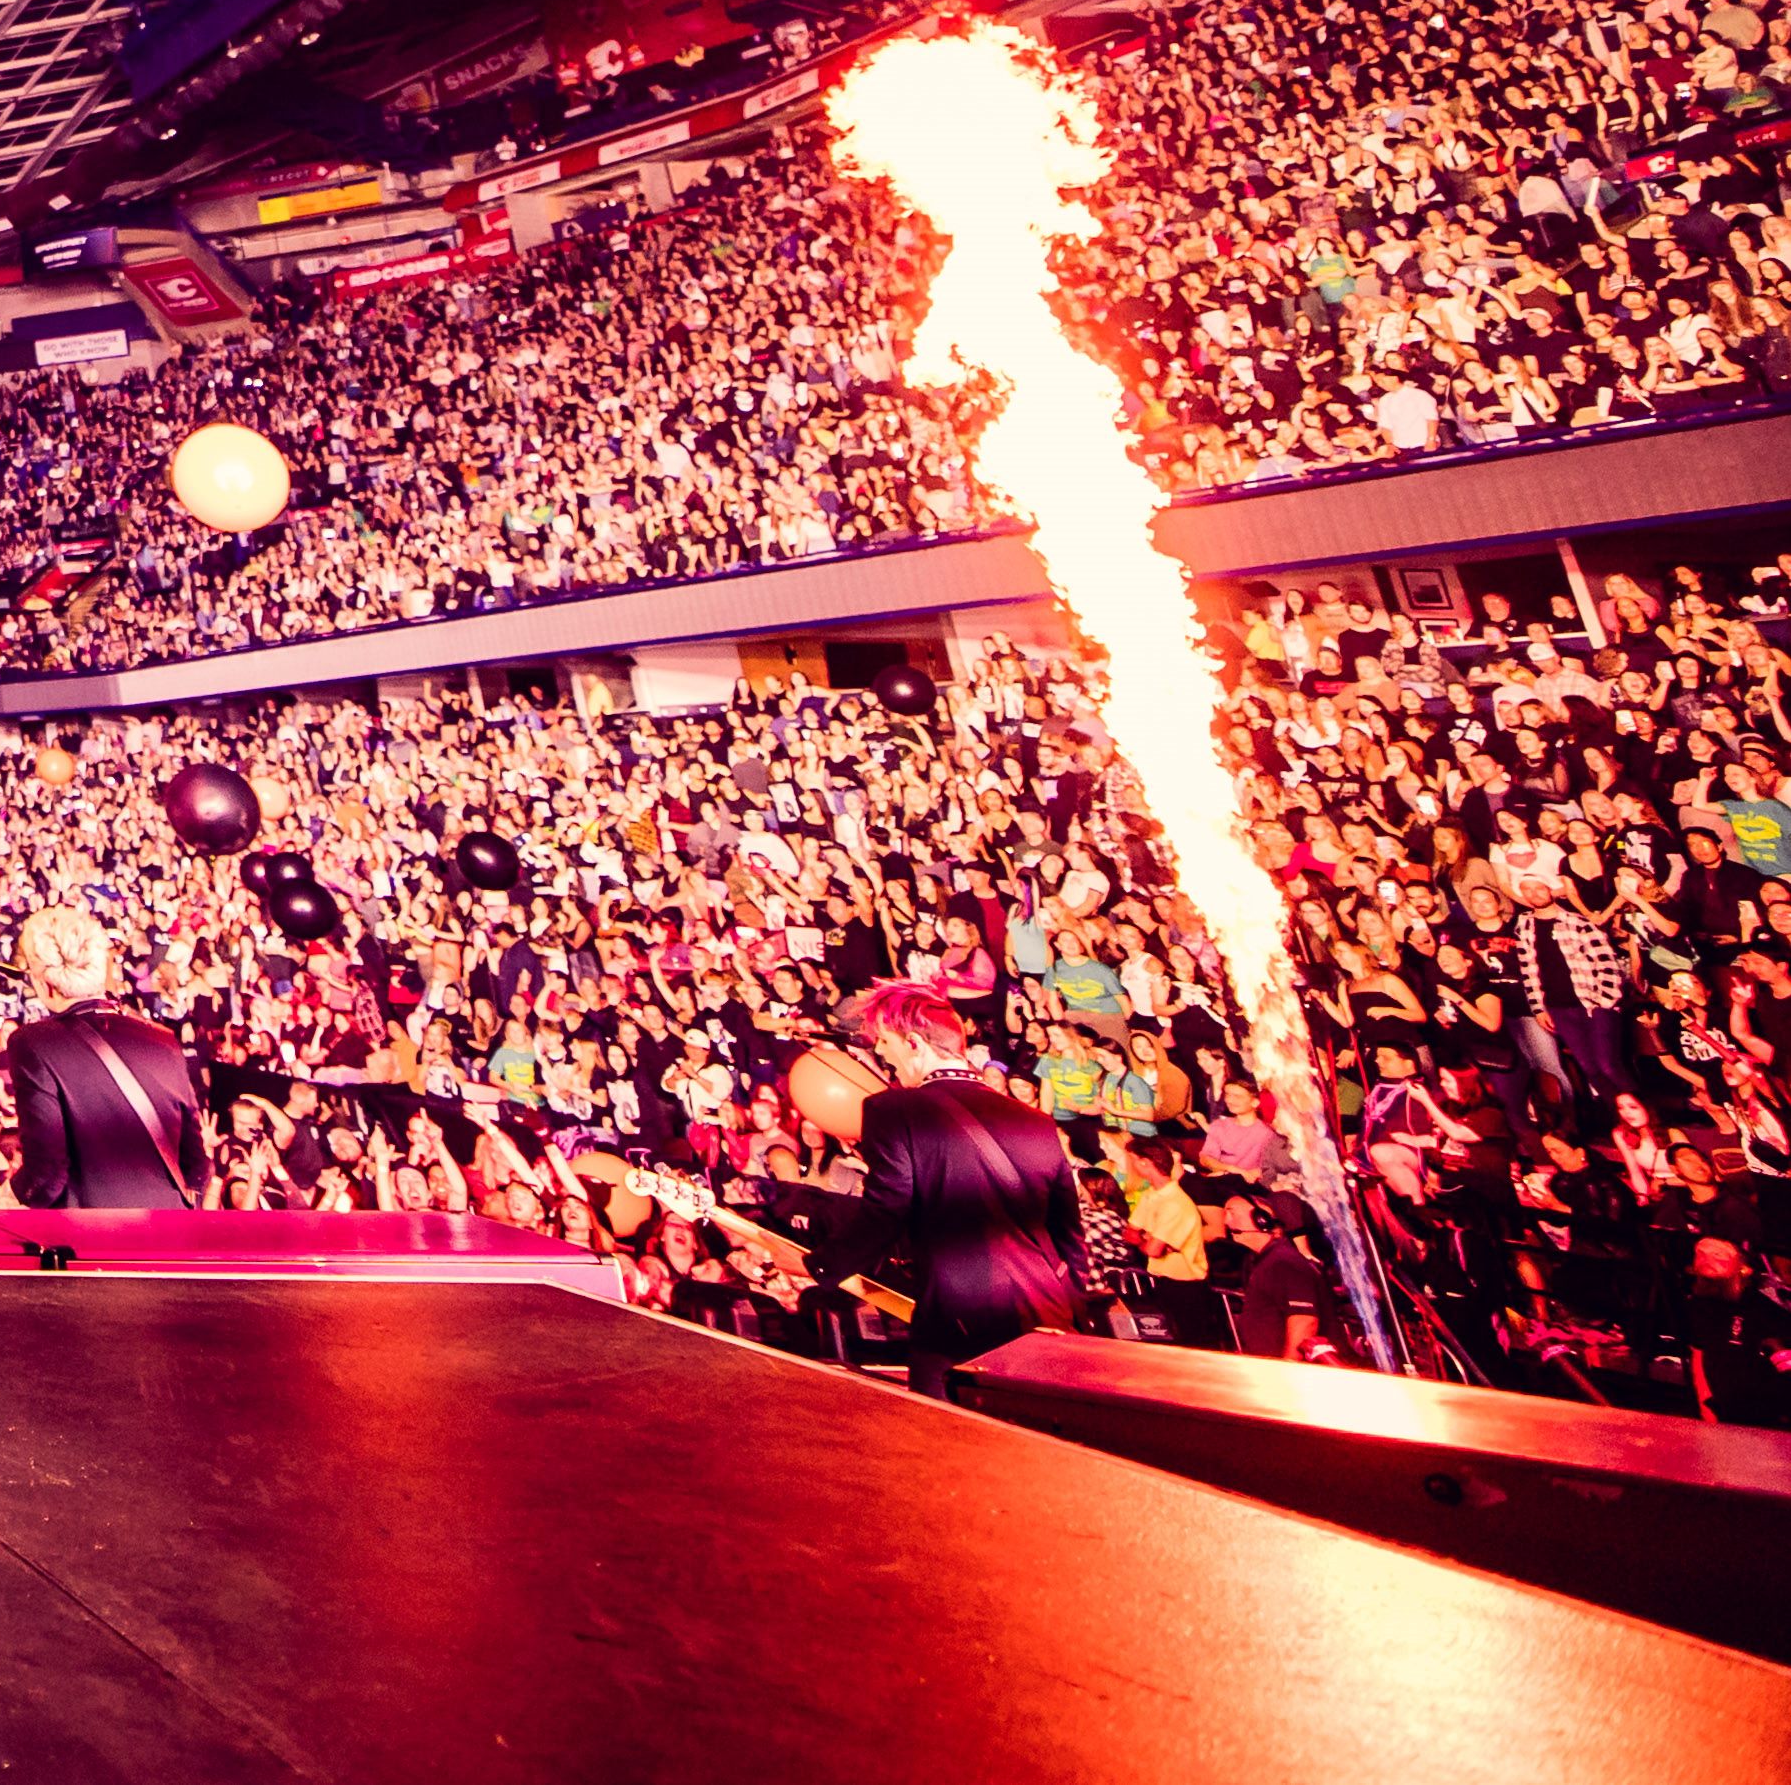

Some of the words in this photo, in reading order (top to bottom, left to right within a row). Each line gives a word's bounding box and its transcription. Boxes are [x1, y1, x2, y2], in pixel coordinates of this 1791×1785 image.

[381, 255, 449, 281] CORNER
[43, 341, 58, 353] GO
[59, 338, 86, 351] WITH
[87, 335, 119, 347] THOSE
[54, 348, 77, 359] WHO
[80, 345, 111, 357] KNOW
